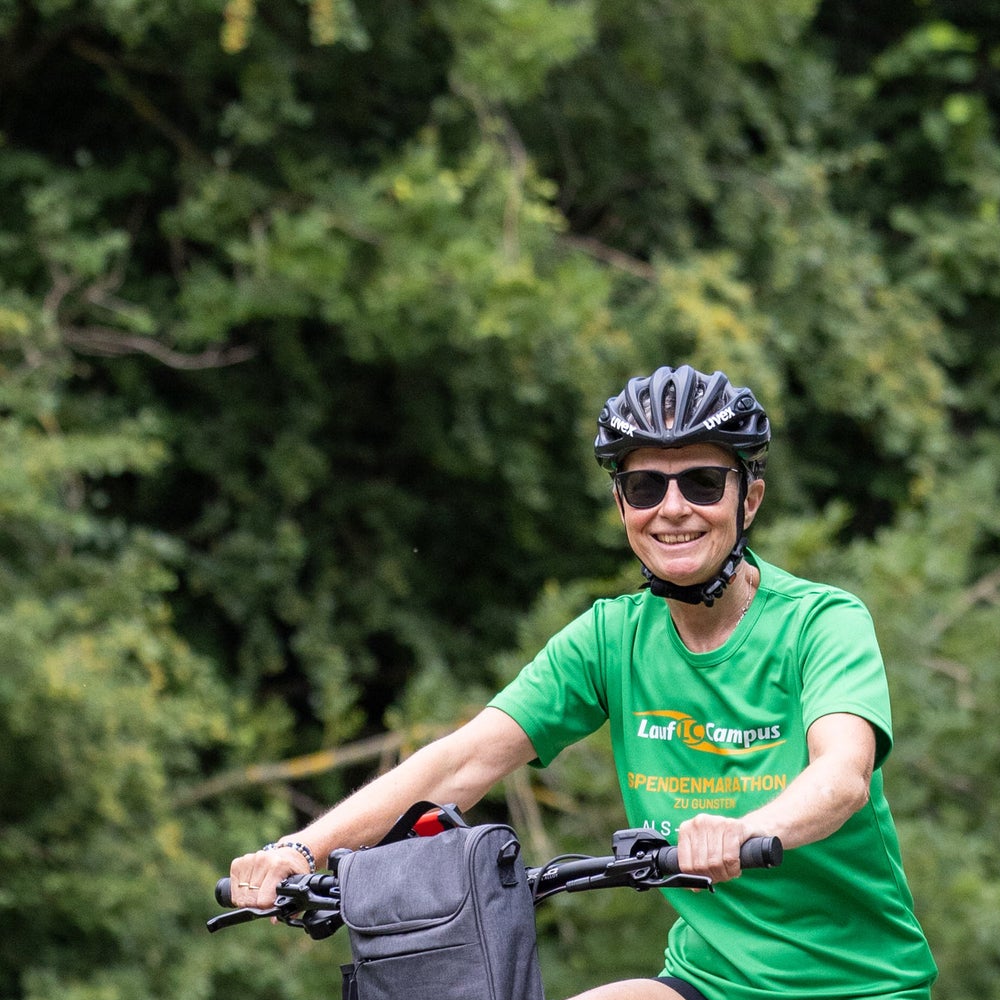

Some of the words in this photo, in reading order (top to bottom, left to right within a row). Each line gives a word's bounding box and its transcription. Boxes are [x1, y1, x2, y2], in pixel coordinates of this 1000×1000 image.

[610, 416, 637, 437] uvex
[703, 406, 736, 430] uvex
[638, 719, 677, 741] Lauf
[706, 722, 781, 747] Campus
[627, 772, 787, 793] SPENDENMARATHON
[673, 798, 689, 809] ZU
[691, 798, 736, 810] GUNSTEN
